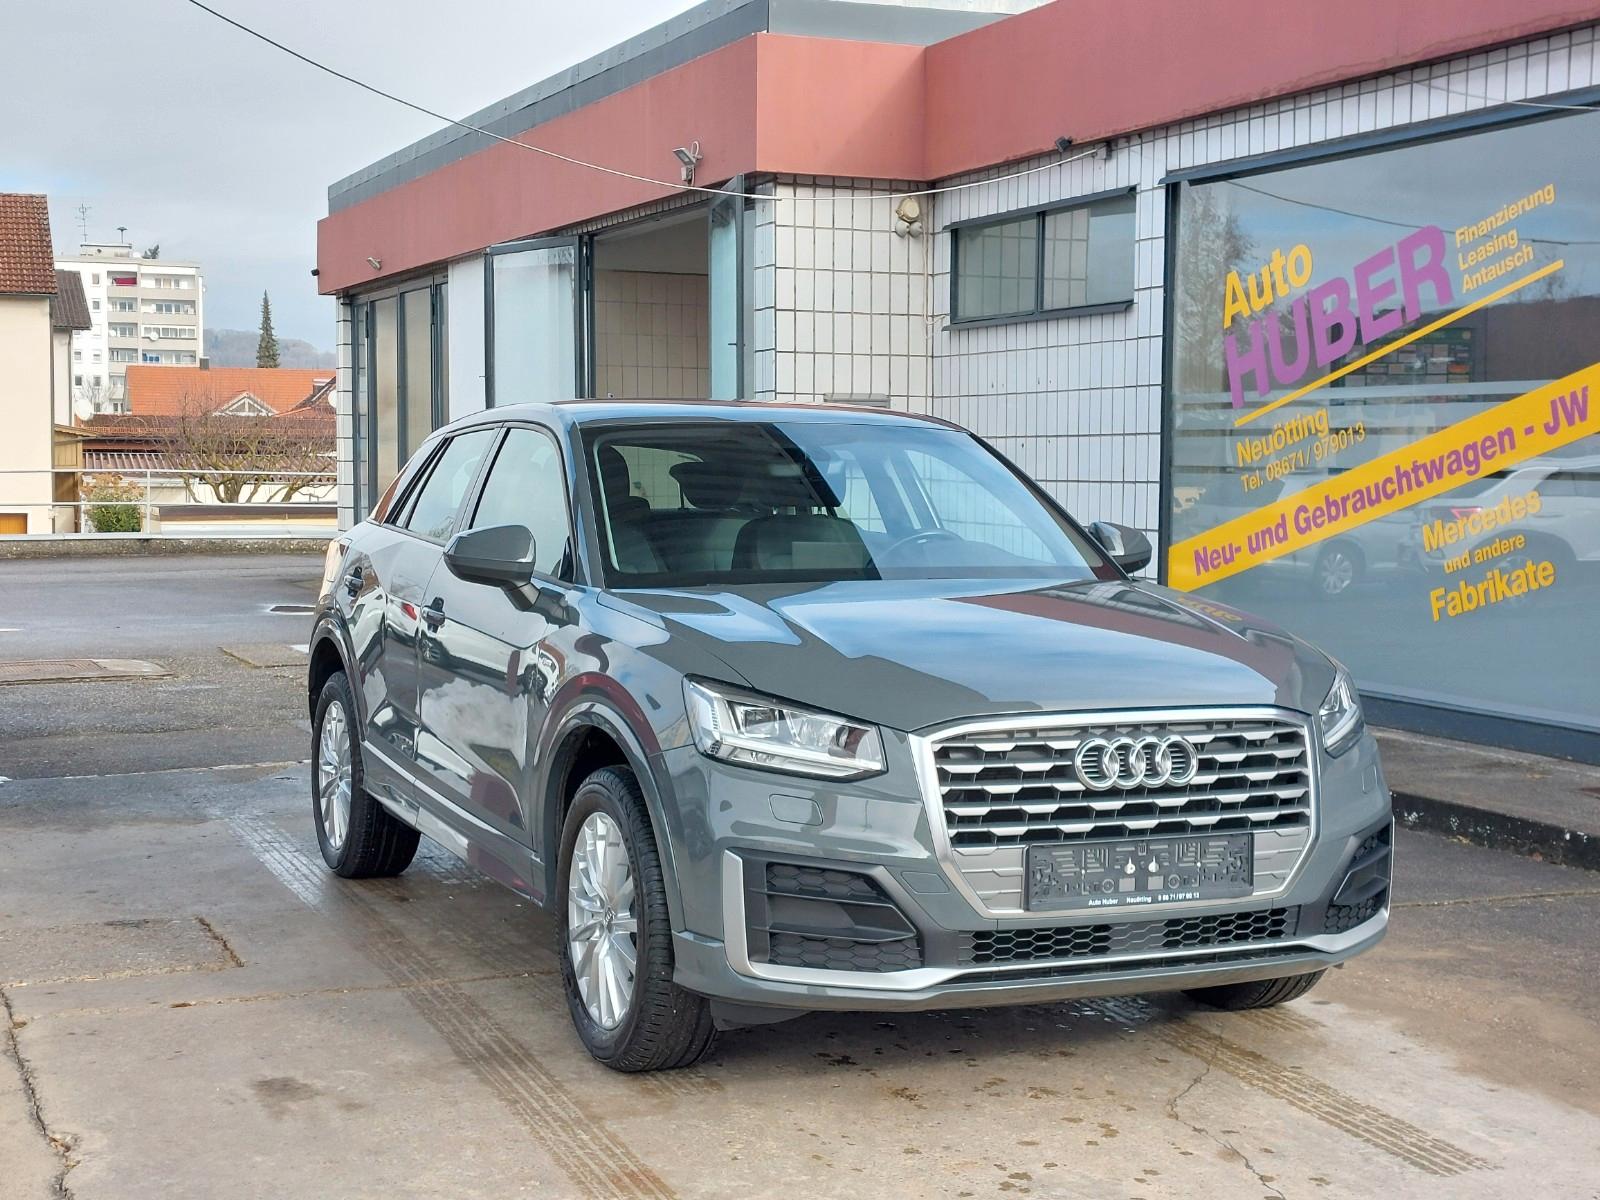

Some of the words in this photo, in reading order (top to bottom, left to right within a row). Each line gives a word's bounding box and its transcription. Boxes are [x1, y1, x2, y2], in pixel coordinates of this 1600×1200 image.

[1456, 183, 1555, 248] Finanzierung
[1458, 229, 1518, 270] Leasing
[1463, 244, 1534, 293] Antausch
[1223, 243, 1313, 329] Auto
[1224, 225, 1454, 409] HUBER
[1236, 407, 1329, 467] Neuötting
[1193, 542, 1242, 577] Neu-
[1247, 513, 1289, 554] und
[1293, 425, 1516, 535] Gebrauchtwagen
[1543, 385, 1590, 436] JW
[1241, 471, 1264, 493] Tel.
[1423, 490, 1542, 553] Mercedes
[1444, 548, 1472, 574] und
[1474, 534, 1526, 563] andere
[1430, 559, 1555, 622] Fabrikate
